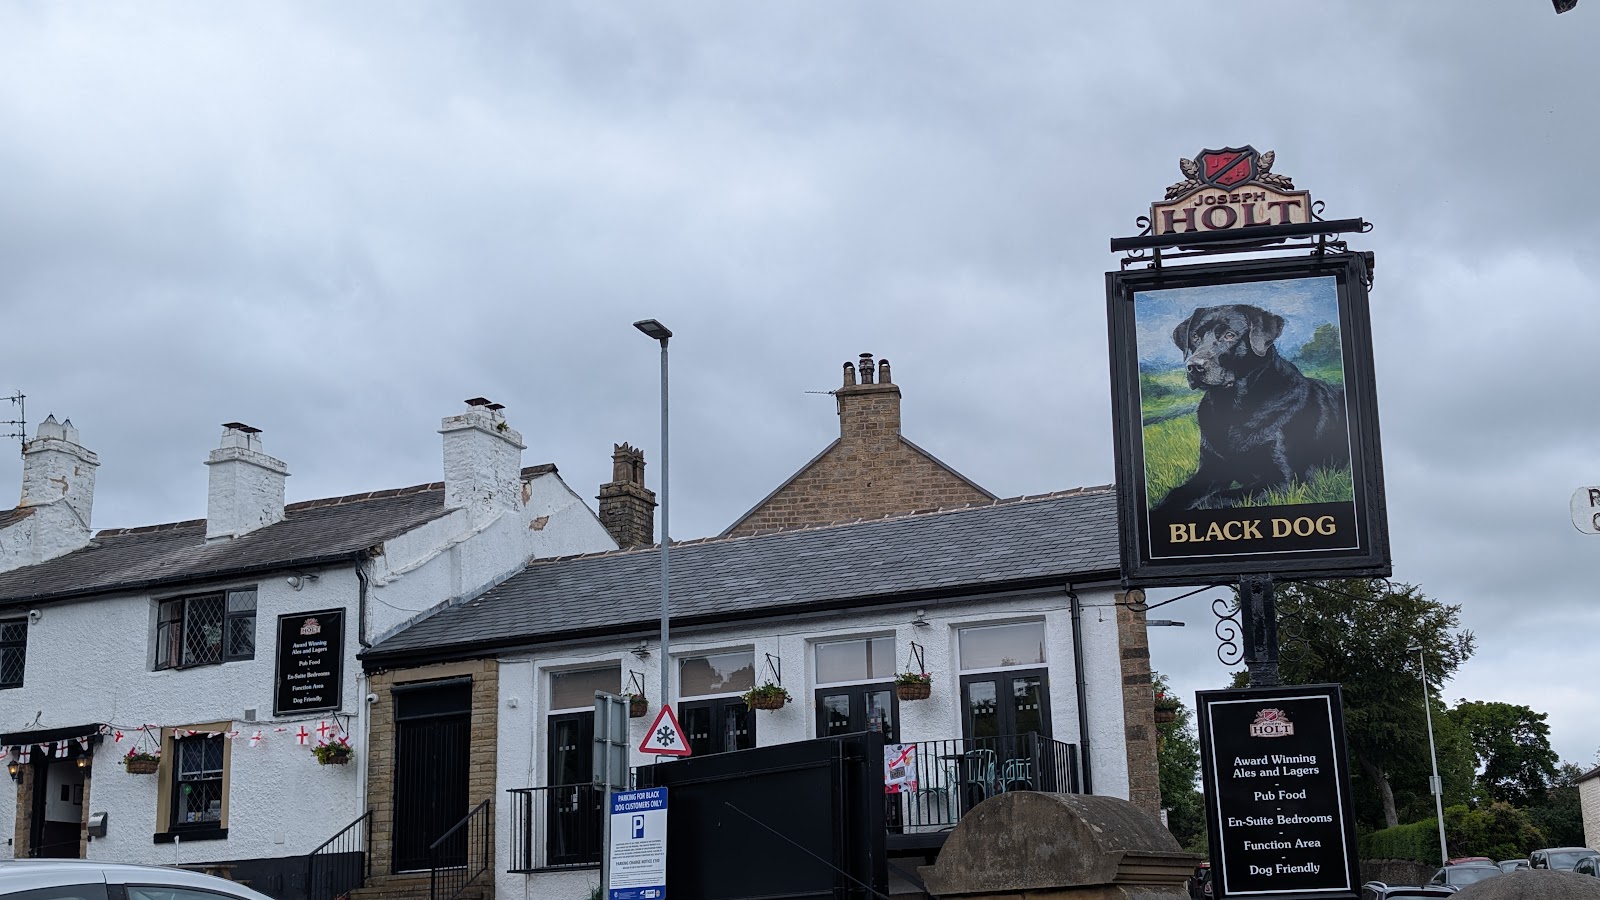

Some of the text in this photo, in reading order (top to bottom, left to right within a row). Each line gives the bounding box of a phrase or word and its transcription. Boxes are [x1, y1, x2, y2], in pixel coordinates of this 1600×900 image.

[1194, 191, 1266, 207] JOSEPH
[1161, 200, 1301, 234] HOLT
[1169, 515, 1337, 543] BLACK DOG
[1253, 725, 1290, 734] HOLT
[1234, 754, 1317, 766] Award Winning
[1233, 766, 1320, 778] Ales and Lagers
[618, 791, 660, 801] PARKING FOR BLACK
[1254, 789, 1306, 801] Pub Food
[625, 800, 650, 810] CUSTOMERS
[633, 816, 644, 838] P
[1228, 814, 1332, 827] En-Suite Bedrooms
[1244, 838, 1321, 851] Function Area
[1250, 862, 1320, 877] Dog Friendly
